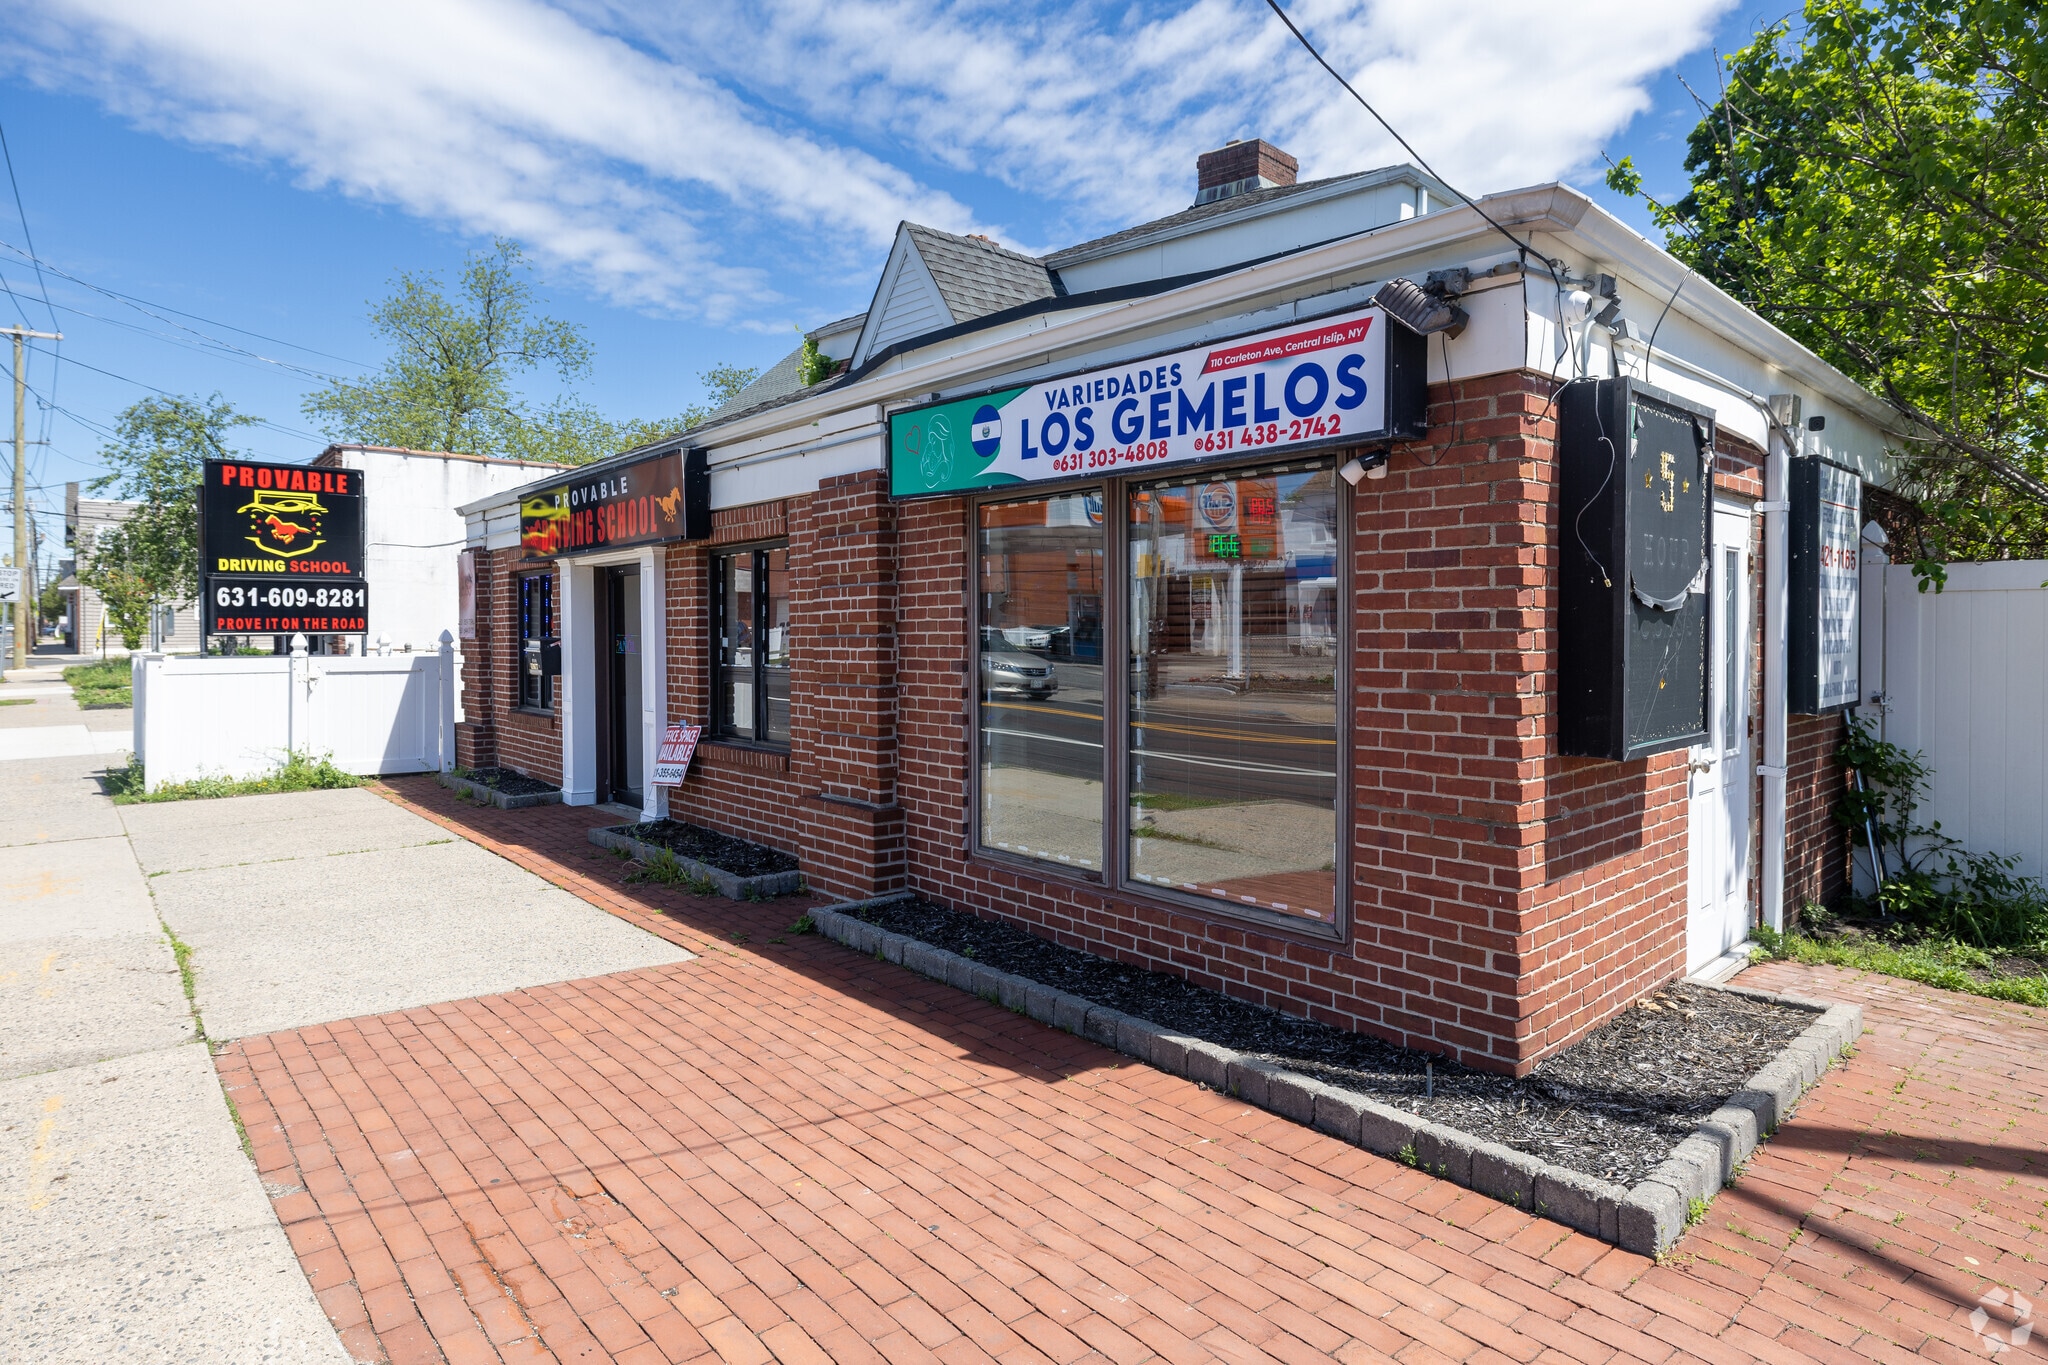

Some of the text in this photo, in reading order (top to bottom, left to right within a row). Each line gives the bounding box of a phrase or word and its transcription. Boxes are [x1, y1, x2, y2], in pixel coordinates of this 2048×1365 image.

[1210, 326, 1364, 368] 110 Carleton Ave, Central Islip, NY
[1045, 363, 1182, 411] VARIEDADES
[1021, 354, 1368, 460] LOS GEMELOS
[1204, 413, 1341, 452] 631 438-2742
[1060, 440, 1168, 472] 631 303-4808
[221, 465, 348, 494] PROVABLE
[554, 476, 628, 510] PROVABLE
[1660, 451, 1675, 512] 5
[597, 494, 658, 543] SCHOOL
[218, 558, 351, 574] DRIVING SCHOOL
[216, 587, 365, 608] 631-609-8281
[217, 617, 365, 630] PROVE IT ON THE ROAD
